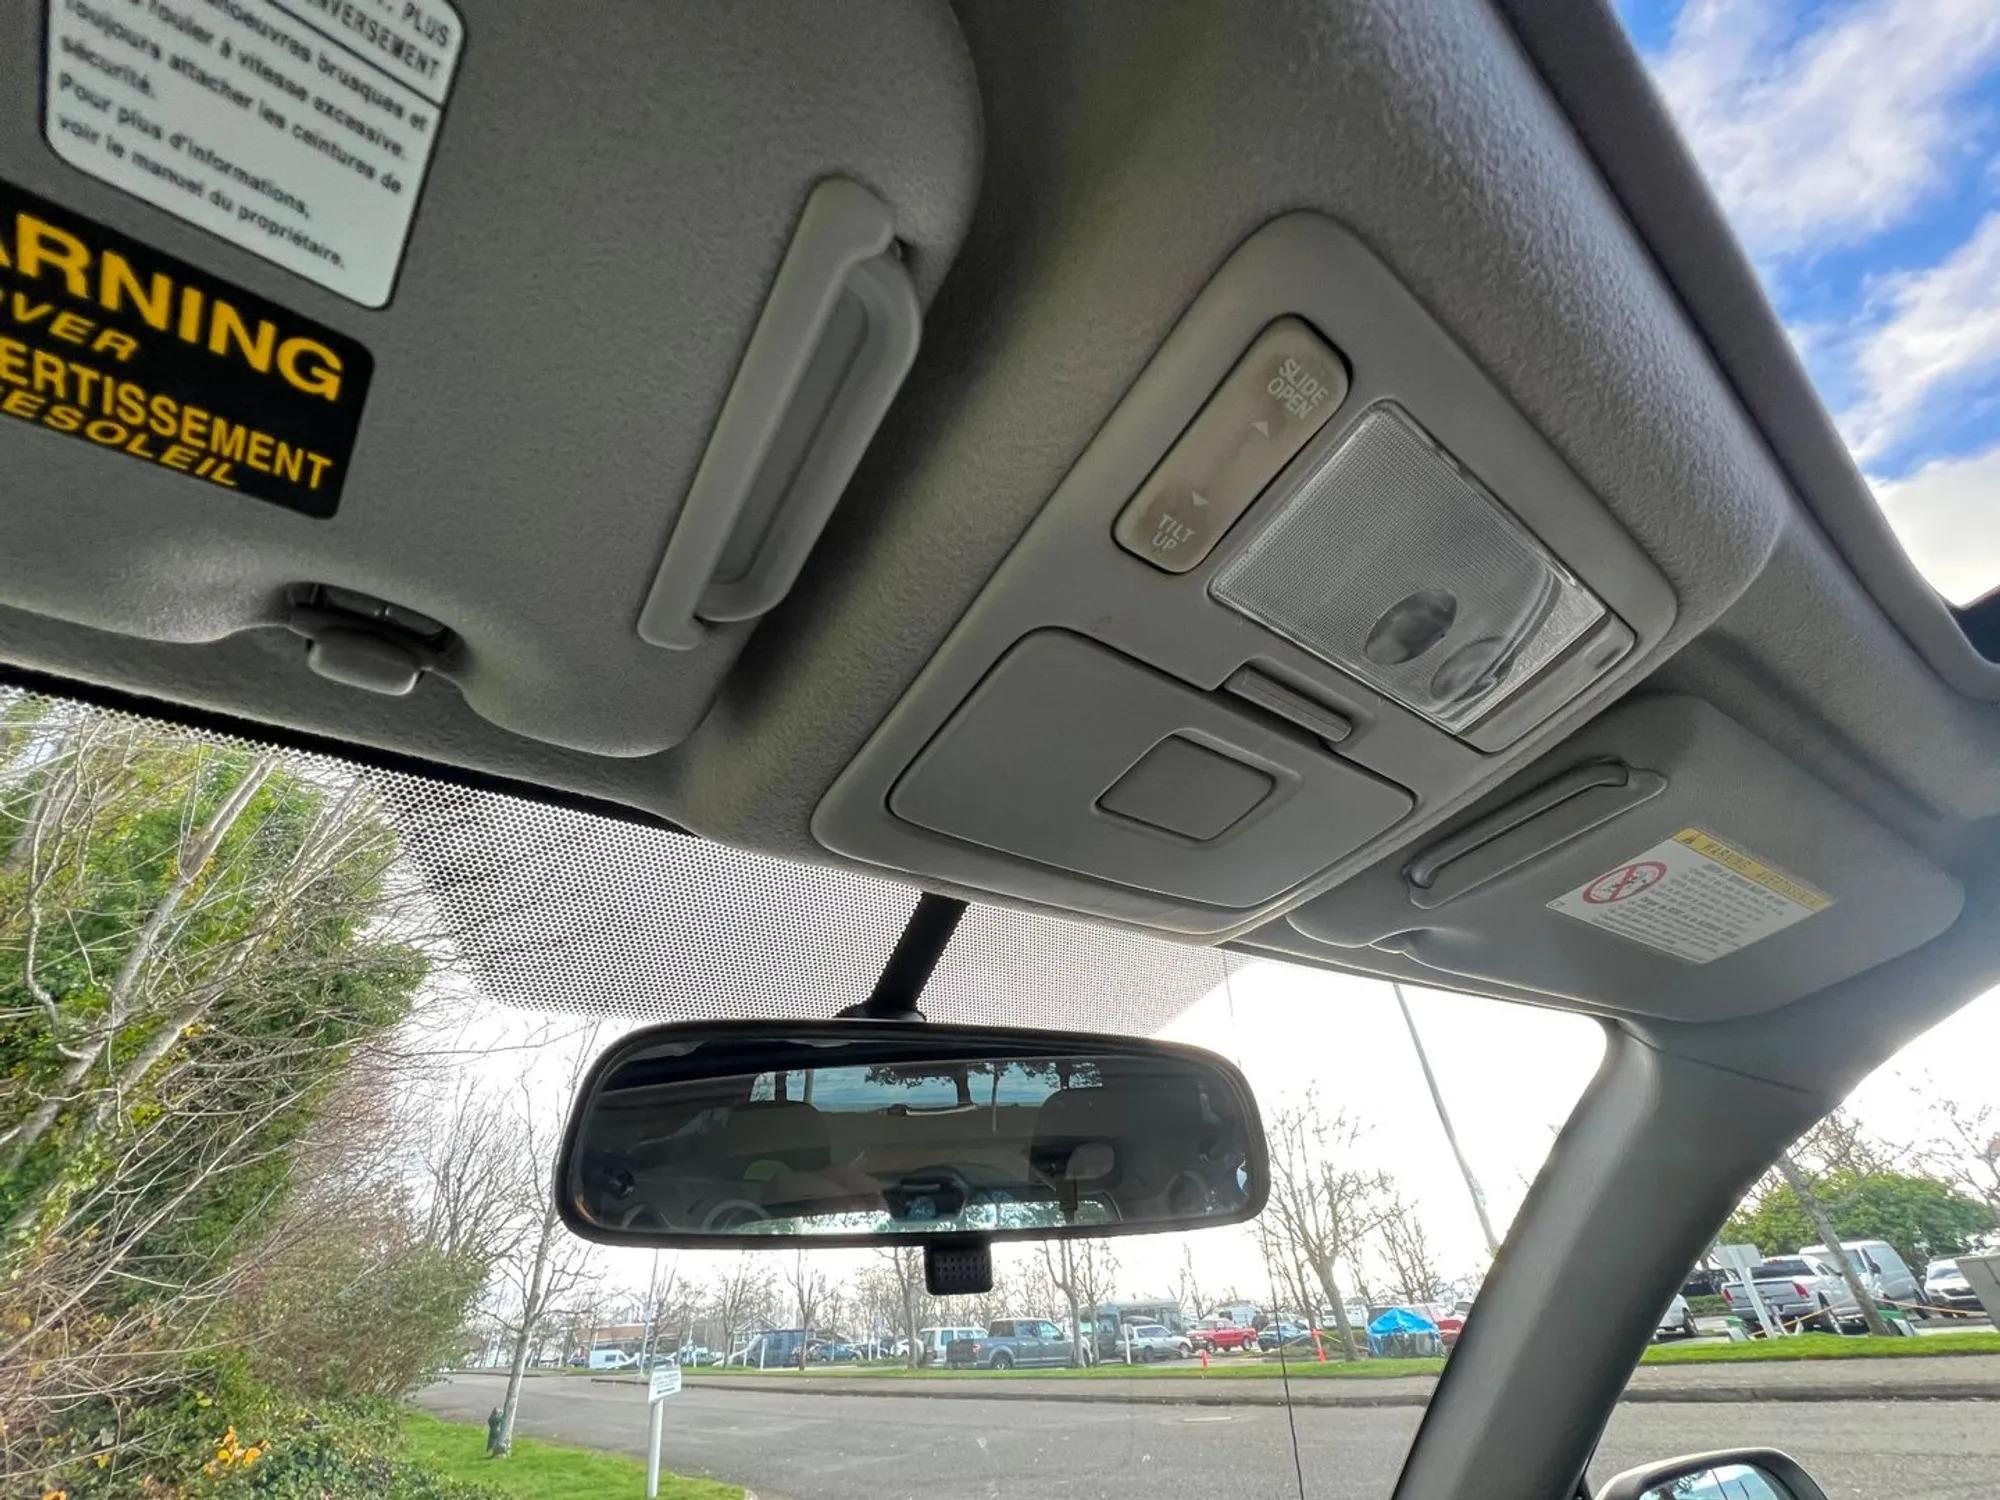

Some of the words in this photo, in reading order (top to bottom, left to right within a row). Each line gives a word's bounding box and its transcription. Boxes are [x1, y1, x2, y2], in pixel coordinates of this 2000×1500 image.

[402, 2, 449, 47] PLUS
[59, 72, 111, 113] Pour
[118, 107, 162, 140] plus
[169, 54, 253, 109] attacher
[258, 99, 286, 129] les
[292, 124, 376, 179] ceintures
[380, 171, 402, 194] de
[238, 51, 308, 101] vitesse
[313, 96, 406, 160] excessive.
[318, 51, 404, 119] brusques
[410, 113, 428, 132] et
[59, 116, 100, 145] voir
[106, 134, 125, 158] le
[132, 151, 204, 198] manuel
[209, 190, 233, 213] du
[0, 288, 138, 361] VER
[1267, 378, 1314, 420] OPEN
[1279, 358, 1329, 406] SLIDE
[0, 384, 238, 487] ESOLEIL
[1152, 531, 1178, 551] UP
[1157, 513, 1196, 543] TILT
